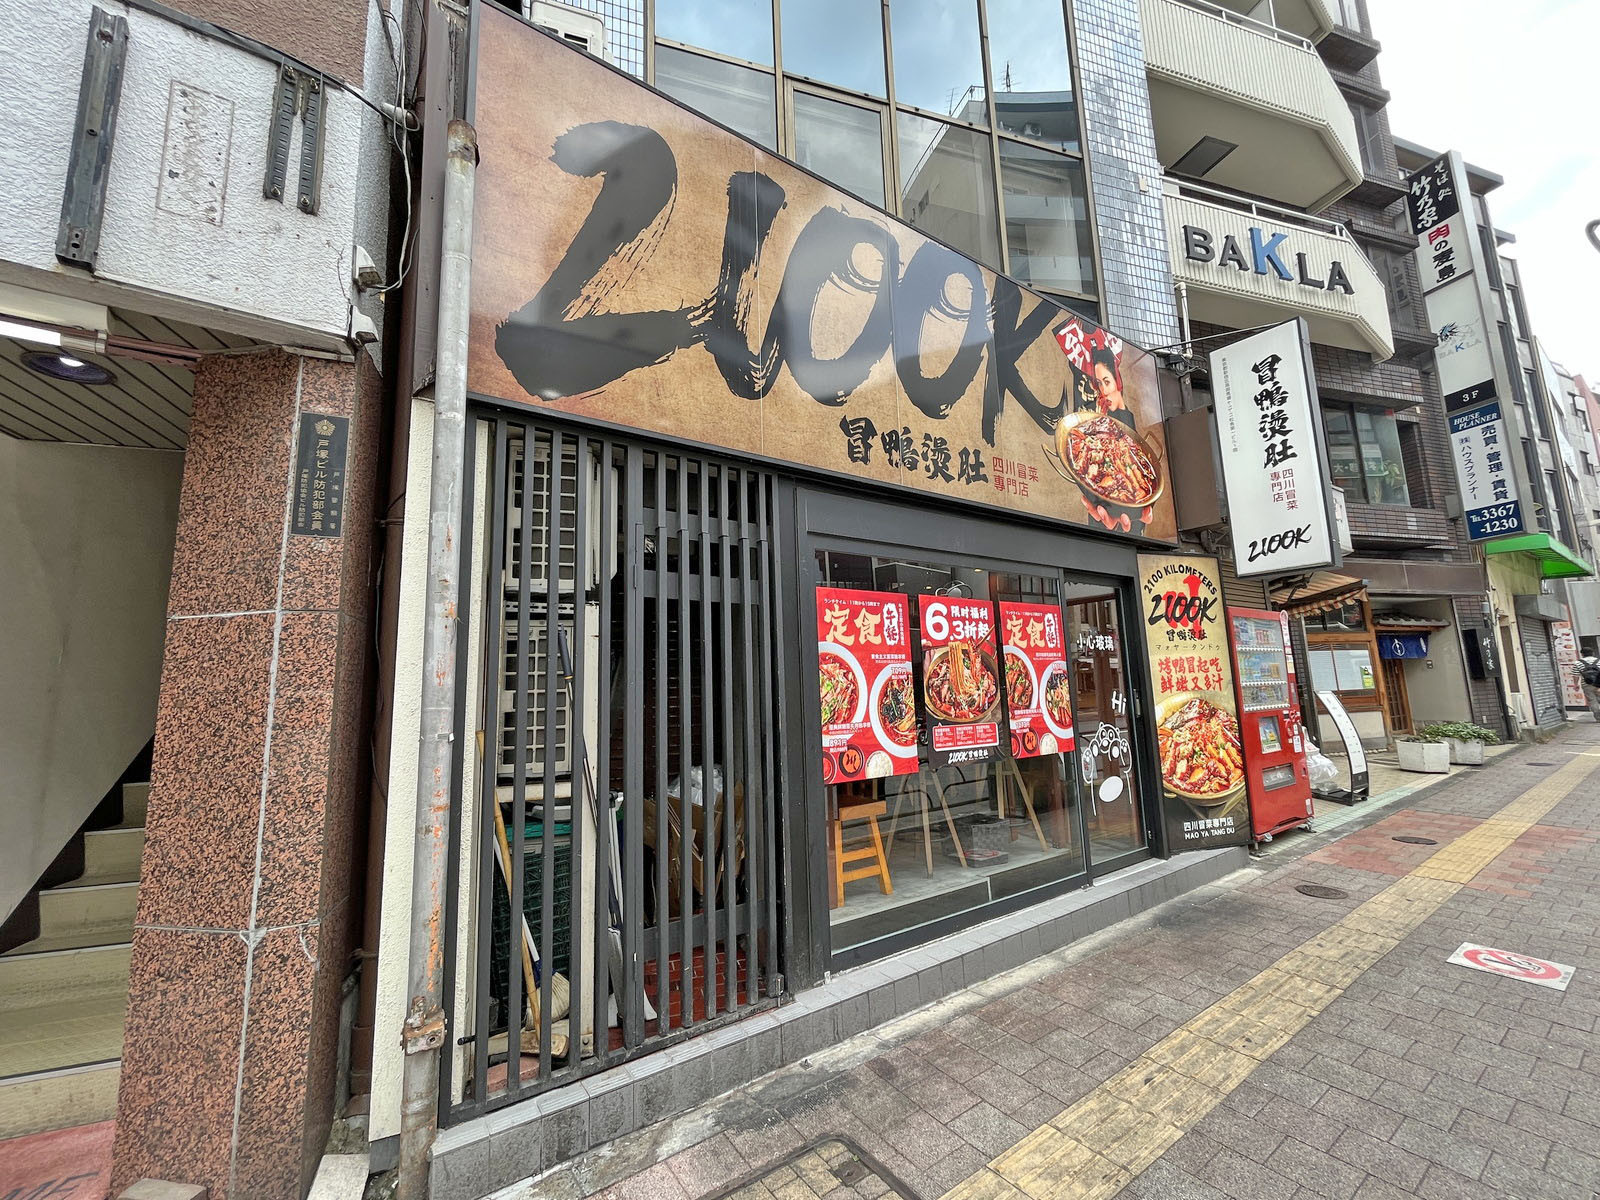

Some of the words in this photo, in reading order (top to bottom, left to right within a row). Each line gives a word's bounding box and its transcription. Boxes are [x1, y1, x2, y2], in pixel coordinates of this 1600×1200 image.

[1182, 224, 1355, 295] BAKLA
[494, 119, 1068, 448] 2100K
[1454, 412, 1480, 425] HOUSE
[1459, 413, 1498, 430] PLANNER
[992, 455, 1039, 483] 四川冒菜
[311, 439, 330, 531] 戸塚ビル防犯部会員
[1282, 468, 1298, 510] 四川冒菜
[1480, 517, 1518, 534] -1230
[1481, 503, 1515, 521] 3367
[1248, 524, 1312, 562] 2100K
[1143, 570, 1164, 594] 2100
[1163, 564, 1218, 595] KILOMETERS
[824, 604, 883, 647] 定食
[1148, 594, 1218, 626] 2100K
[1006, 615, 1046, 649] 定食
[1111, 690, 1127, 715] Hi
[1184, 831, 1200, 840] MAO
[1200, 830, 1210, 838] YA
[1210, 828, 1226, 837] TANG
[1226, 827, 1235, 835] DU
